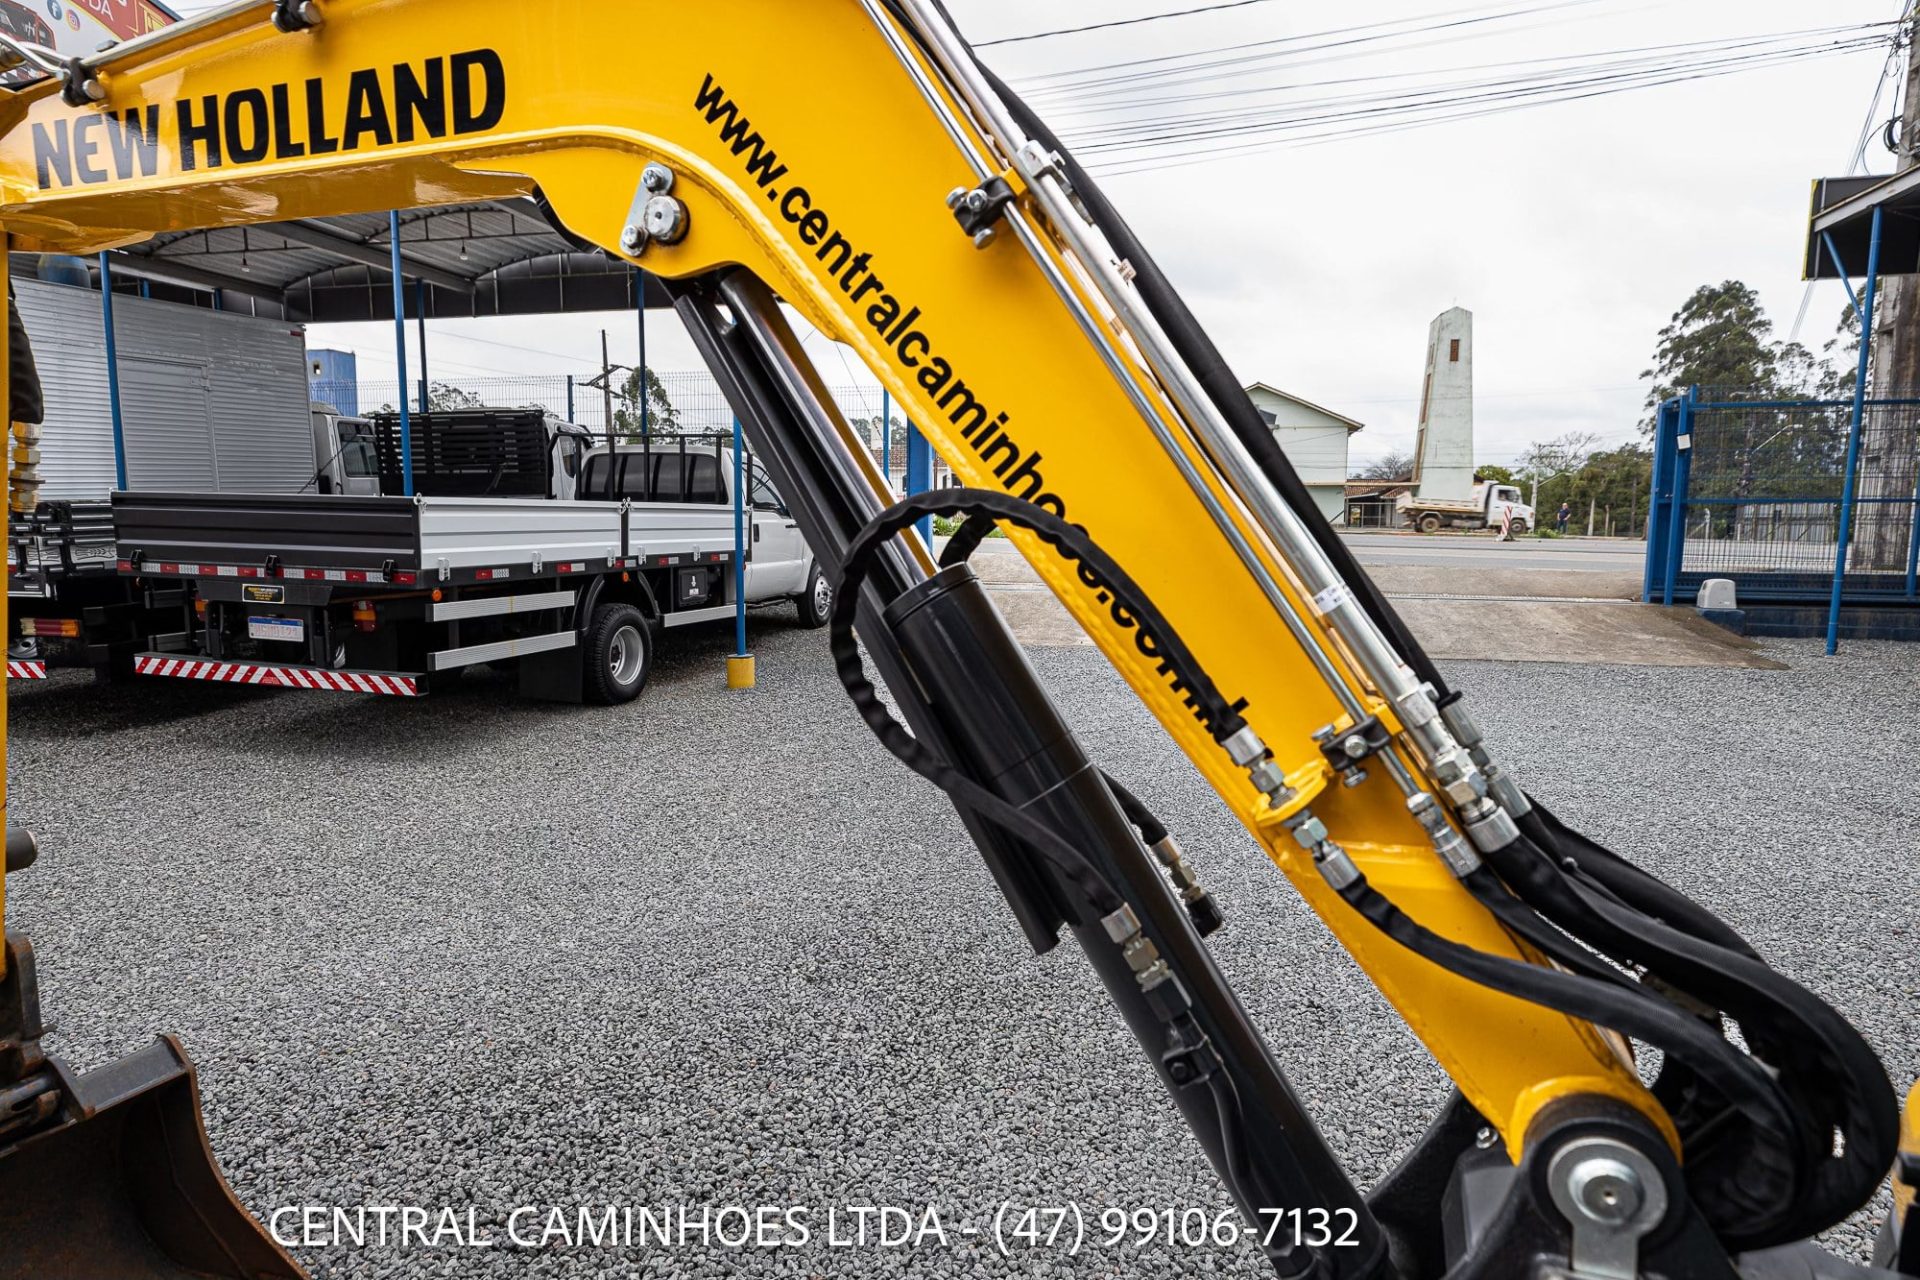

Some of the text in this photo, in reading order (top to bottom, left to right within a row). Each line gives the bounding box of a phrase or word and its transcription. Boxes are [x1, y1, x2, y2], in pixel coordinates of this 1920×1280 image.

[32, 48, 506, 190] NEW HOLLAND
[694, 73, 1275, 766] www.centralcaminho.co.
